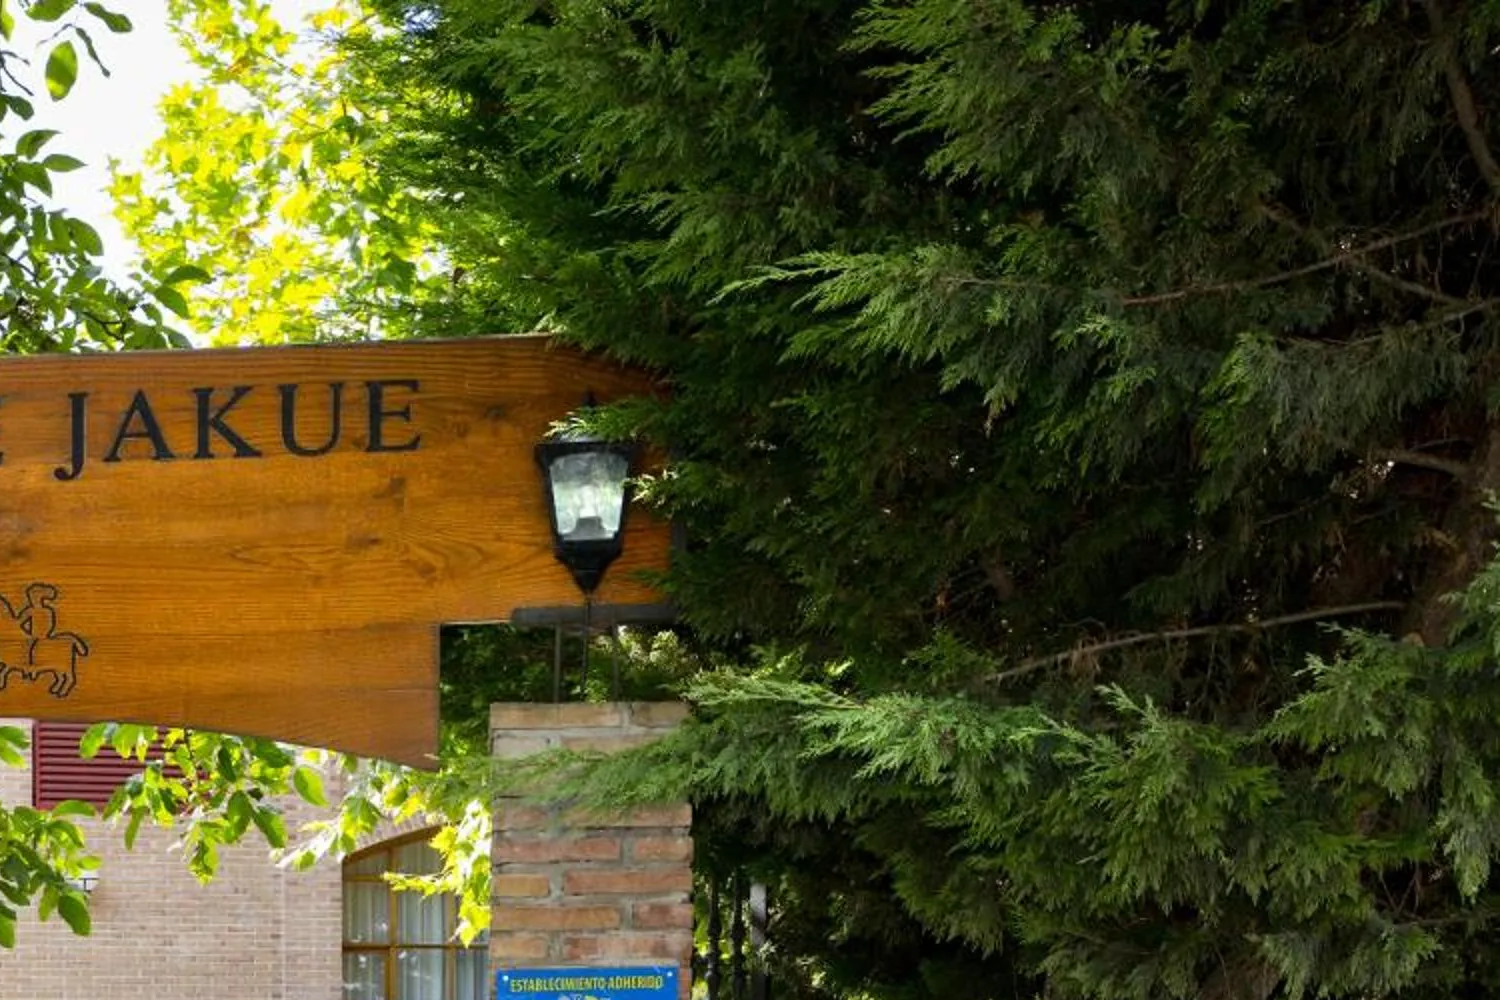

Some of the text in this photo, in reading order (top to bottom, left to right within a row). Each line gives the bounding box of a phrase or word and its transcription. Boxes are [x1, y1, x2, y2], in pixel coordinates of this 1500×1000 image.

[54, 380, 421, 480] JAKUE
[510, 975, 663, 993] ESTABLECIMIENTO ADHERIDO
